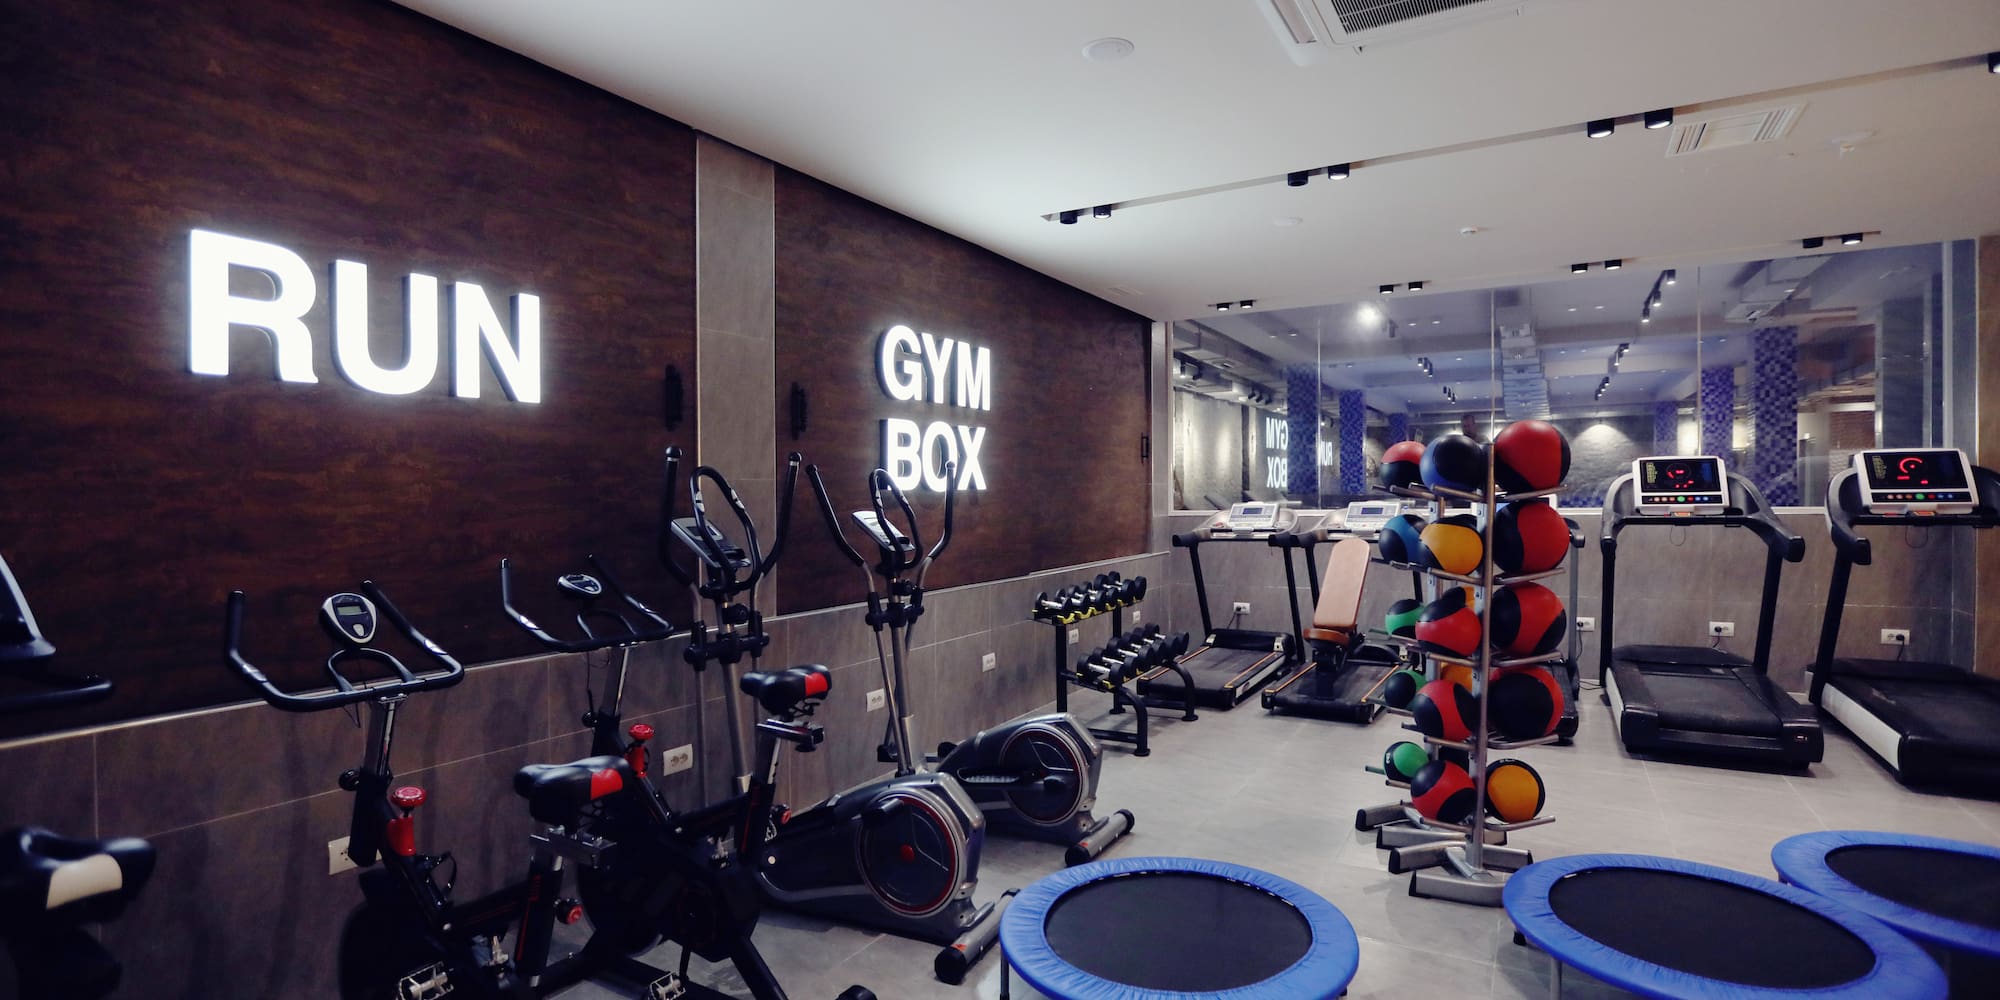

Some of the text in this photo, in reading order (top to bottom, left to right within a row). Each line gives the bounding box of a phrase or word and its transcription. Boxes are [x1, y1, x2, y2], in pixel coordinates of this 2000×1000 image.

[188, 229, 541, 404] RUN
[878, 325, 991, 411] GYM
[882, 418, 987, 492] BOX
